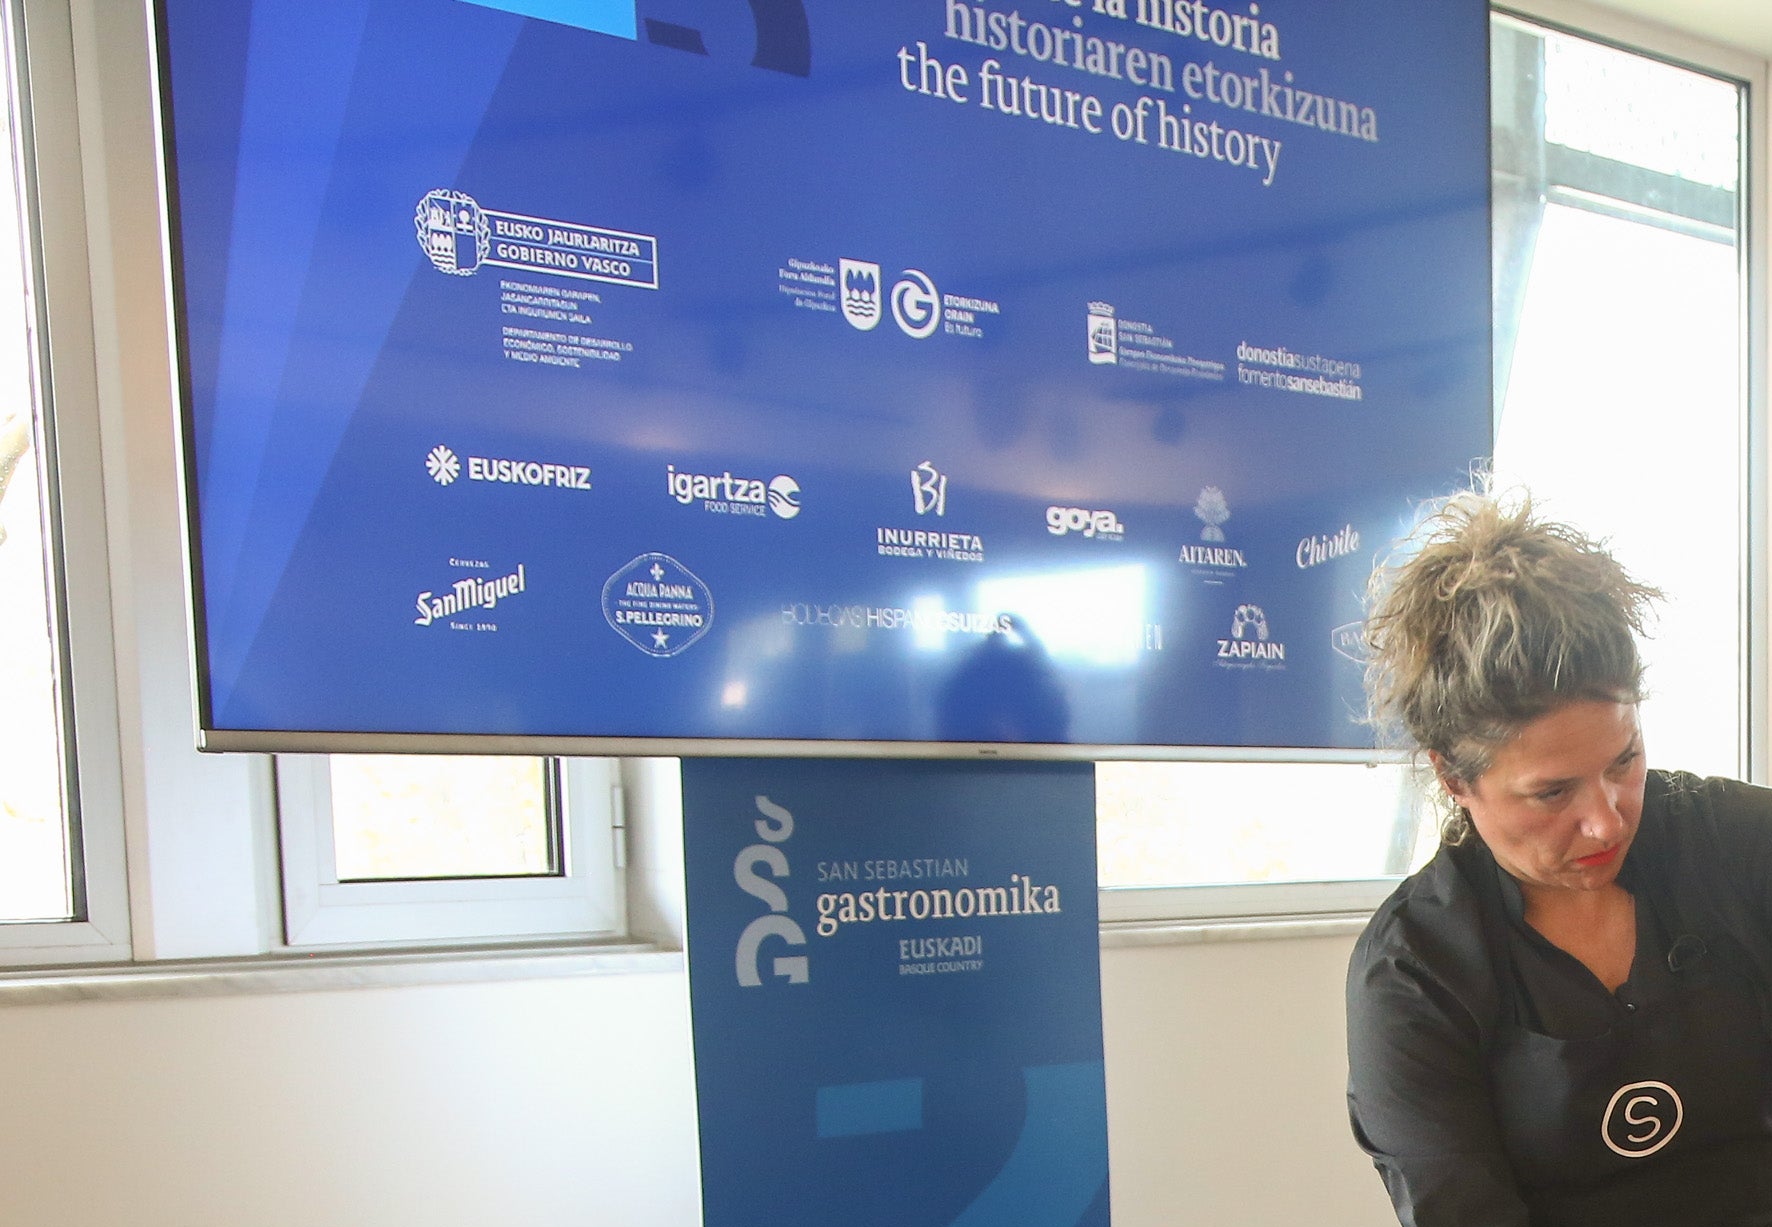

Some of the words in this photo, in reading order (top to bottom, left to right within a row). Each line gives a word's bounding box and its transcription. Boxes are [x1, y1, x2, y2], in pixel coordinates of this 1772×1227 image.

[944, 0, 1175, 92] historiaren
[1182, 60, 1379, 141] etorkizuna
[897, 42, 968, 104] the
[977, 62, 1102, 134] future
[1111, 98, 1151, 144] of
[1157, 103, 1282, 187] history
[495, 220, 544, 241] EUSKO
[547, 228, 640, 257] JAURLARITZA
[496, 243, 578, 269] GOBIERNO
[581, 256, 632, 277] VASCO
[943, 293, 1000, 315] ETORKIZUNA
[943, 308, 975, 325] ORAIN
[468, 456, 592, 490] EUSKOFRIZ
[666, 465, 766, 505] igartza
[704, 500, 729, 515] FOOD
[730, 502, 766, 517] SERVICE
[877, 527, 984, 551] INURRIETA
[1295, 523, 1361, 570] Chivite
[877, 544, 923, 558] BODEGA
[925, 547, 934, 558] Y
[935, 547, 985, 562] VIÑEDOS
[625, 581, 658, 598] ACQUA
[659, 582, 694, 600] PANNA
[615, 610, 704, 627] S.PELLEGRINO
[1216, 639, 1285, 660] ZAPIAIN
[817, 860, 858, 882] SAN
[864, 858, 969, 881] SEBASTIAN
[815, 874, 1062, 938] gastronomika
[898, 934, 982, 960] EUSKADI
[899, 962, 936, 976] BASQUE
[937, 959, 984, 974] COUNTRY
